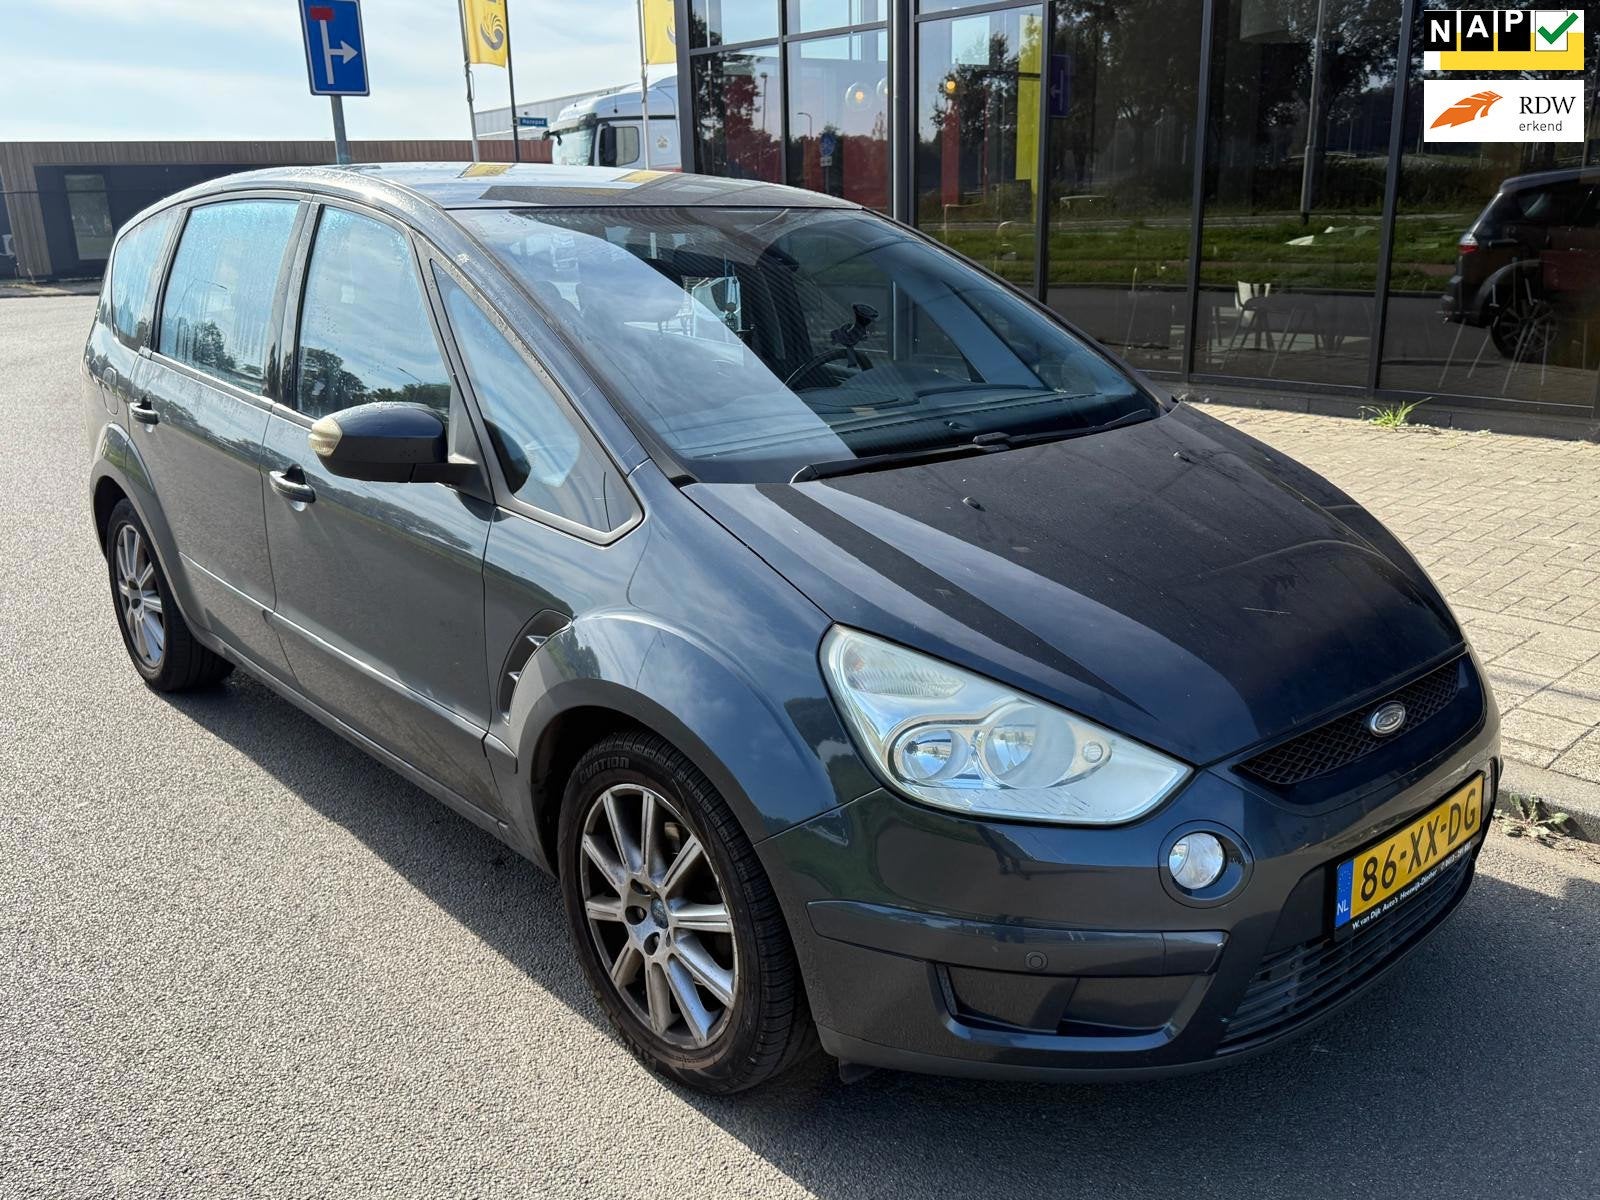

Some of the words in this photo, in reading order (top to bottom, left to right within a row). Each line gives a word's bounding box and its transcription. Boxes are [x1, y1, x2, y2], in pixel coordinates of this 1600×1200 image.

[1361, 788, 1476, 902] 86-XX-DG
[1336, 901, 1349, 916] NL
[1360, 916, 1370, 925] van
[1370, 907, 1381, 918] Dijk
